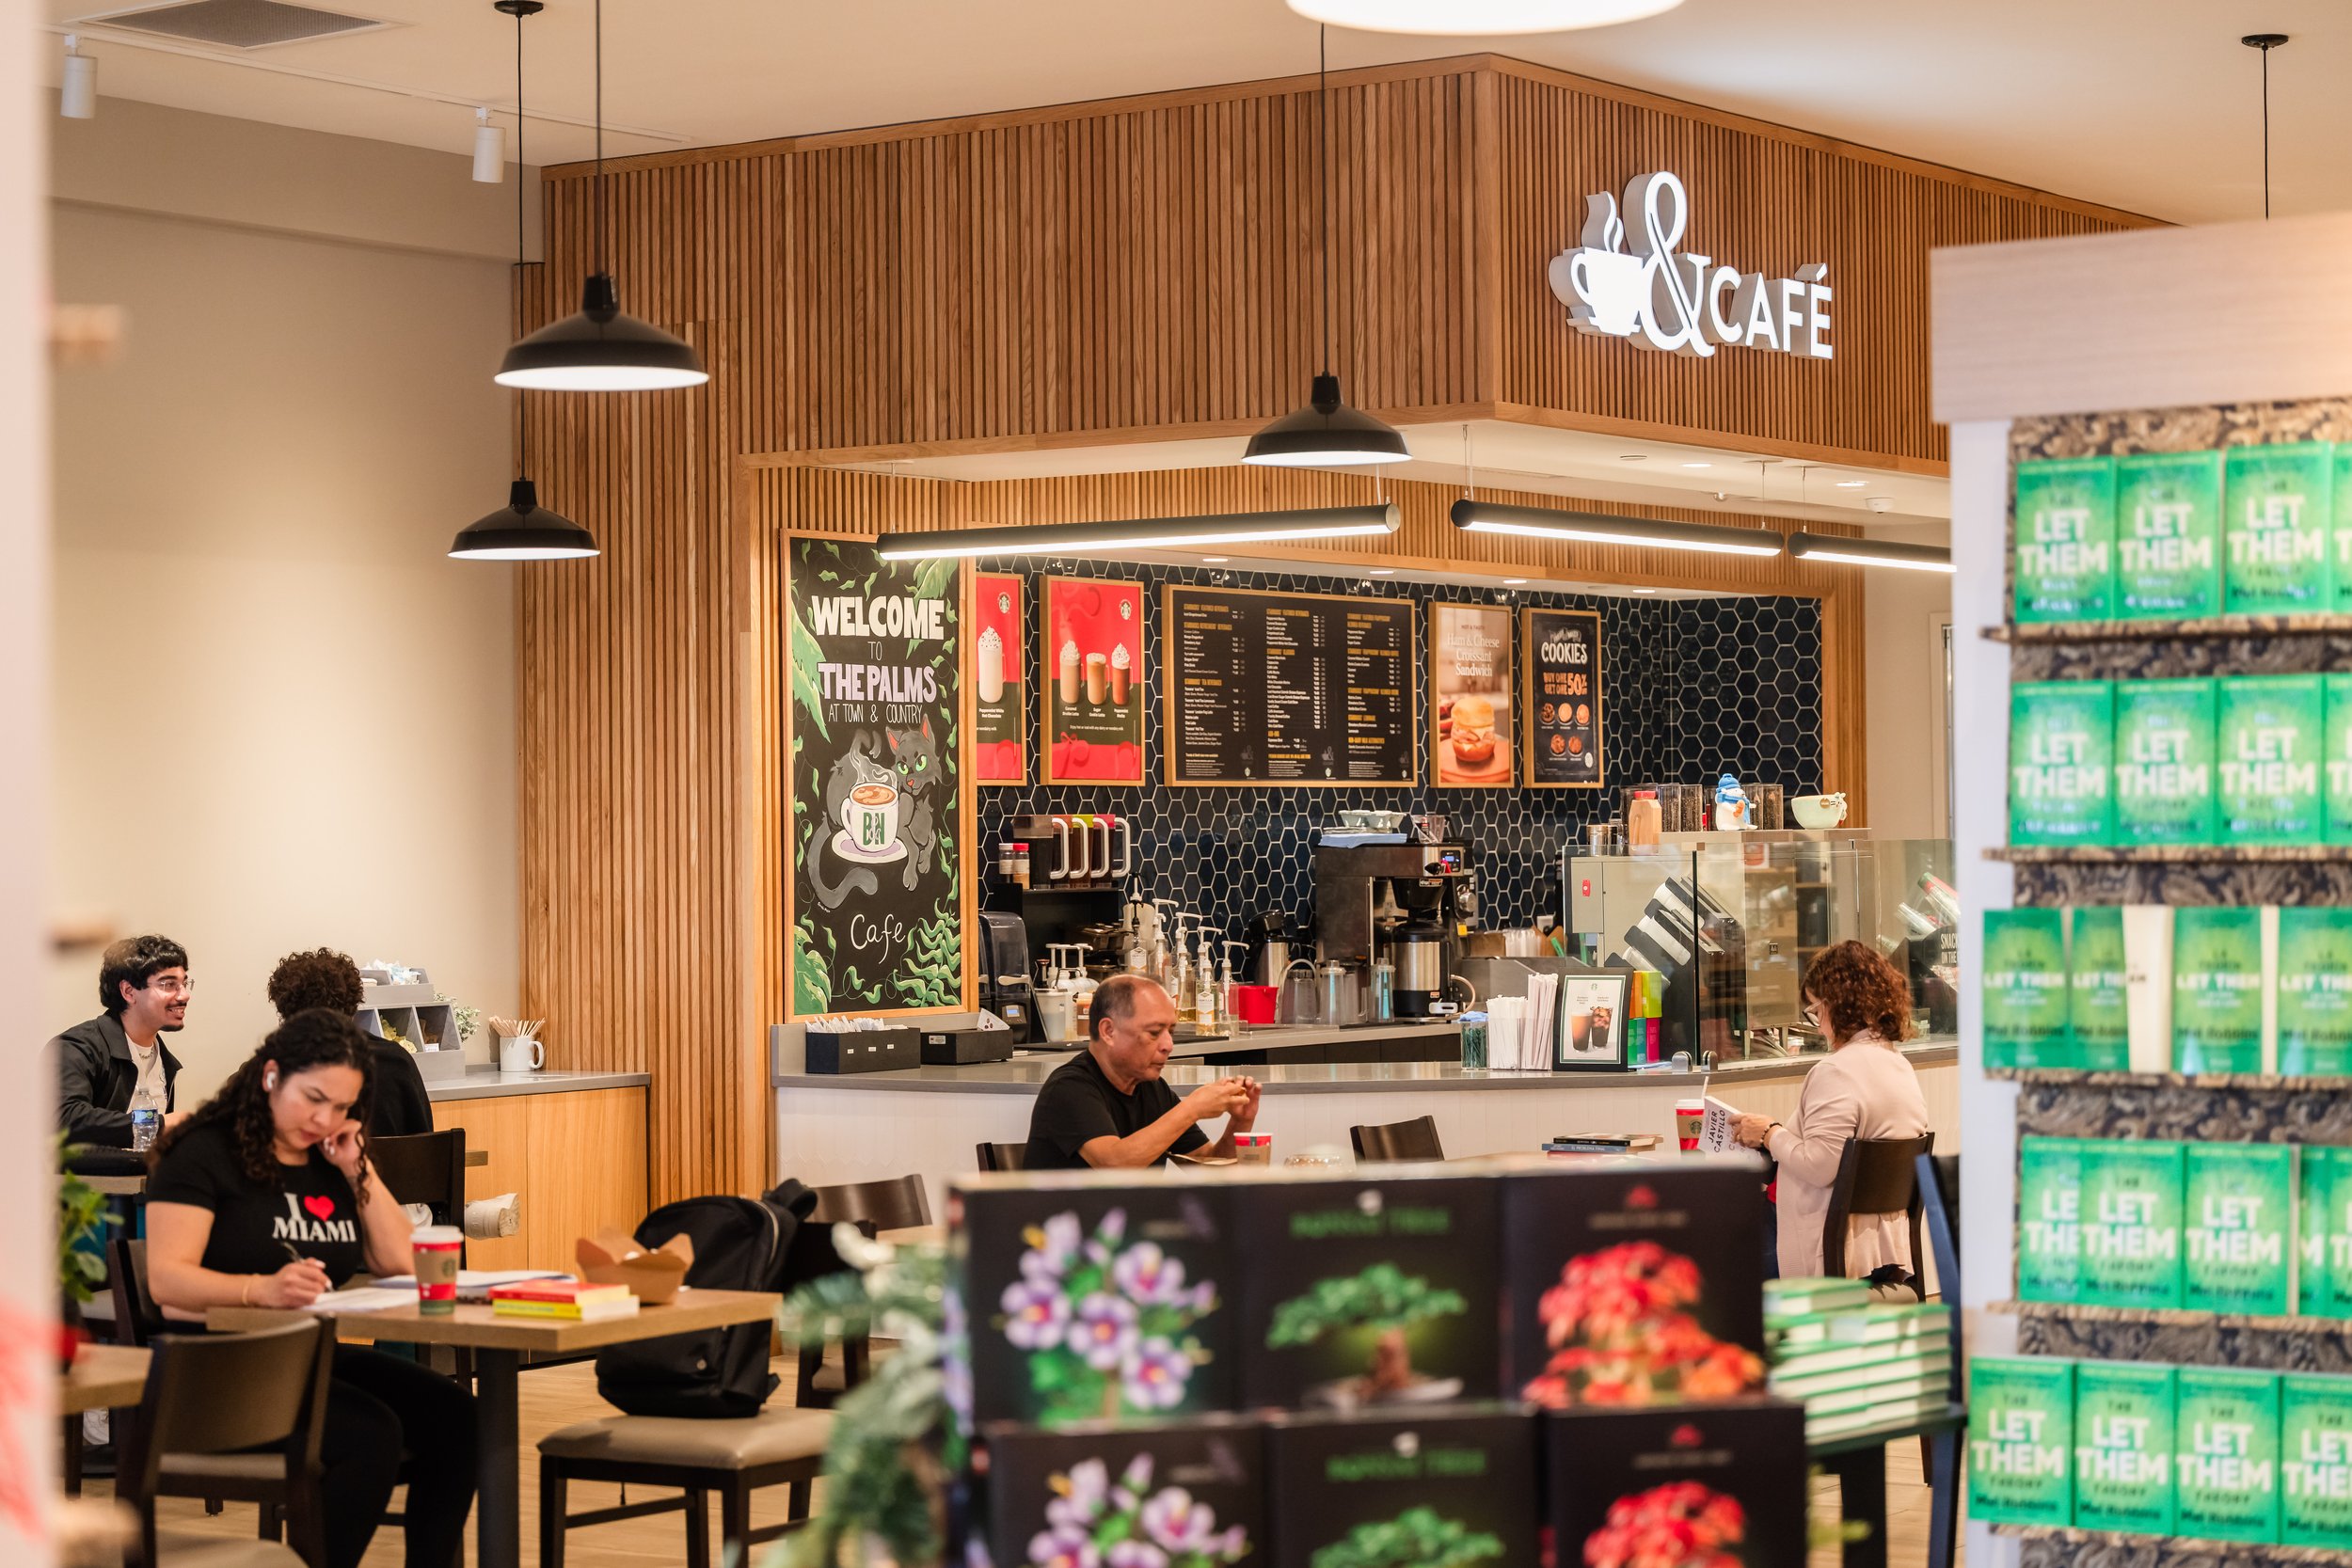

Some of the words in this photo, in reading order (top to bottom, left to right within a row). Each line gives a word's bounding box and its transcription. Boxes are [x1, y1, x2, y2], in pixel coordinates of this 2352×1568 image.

[1641, 170, 1715, 357] &
[1709, 261, 1833, 360] CAFÉ
[2034, 508, 2091, 544] LET
[2135, 502, 2195, 538] LET
[2246, 494, 2305, 530] LET
[2016, 540, 2109, 577] THEM
[2117, 535, 2214, 573] THEM
[2226, 527, 2325, 564] THEM
[811, 594, 945, 641] WELCOME
[867, 641, 883, 661] TO
[1447, 632, 1466, 646] Ham
[1467, 634, 1473, 647] &
[1473, 633, 1501, 648] Cheese
[1455, 648, 1492, 662] Croissant
[1540, 641, 1588, 665] COOKIES
[818, 662, 865, 701] THE
[866, 664, 937, 704] PALMS
[1455, 662, 1493, 677] Sandwich
[1555, 672, 1567, 684] ONE
[1544, 683, 1556, 694] GET
[1556, 683, 1568, 695] ONE
[828, 704, 840, 722] AT
[870, 705, 879, 723] &
[885, 704, 923, 724] COUNTRY
[2030, 731, 2090, 765] LET
[2132, 728, 2190, 764] LET
[2237, 726, 2298, 761] LET
[2012, 765, 2107, 799] THEM
[2114, 763, 2209, 798] THEM
[2218, 761, 2316, 796] THEM
[862, 812, 885, 847] B&N
[850, 912, 906, 965] Cafe
[1708, 1110, 1718, 1144] JAVIER
[1713, 1109, 1726, 1153] CASTILLO
[284, 1192, 303, 1222] I
[2041, 1188, 2079, 1222] LE
[2098, 1191, 2159, 1225] LET
[2201, 1195, 2264, 1229] LET
[272, 1216, 357, 1243] MIAMI
[2024, 1220, 2079, 1255] THE
[2082, 1223, 2178, 1260] THEM
[2184, 1227, 2282, 1266] THEM
[1987, 1408, 2047, 1442] LET
[2091, 1415, 2151, 1449] LET
[2193, 1421, 2254, 1456] LET
[1970, 1439, 2065, 1479] THEM
[2074, 1446, 2169, 1486] THEM
[2175, 1453, 2272, 1493] THEM
[2281, 1460, 2352, 1498] THE
